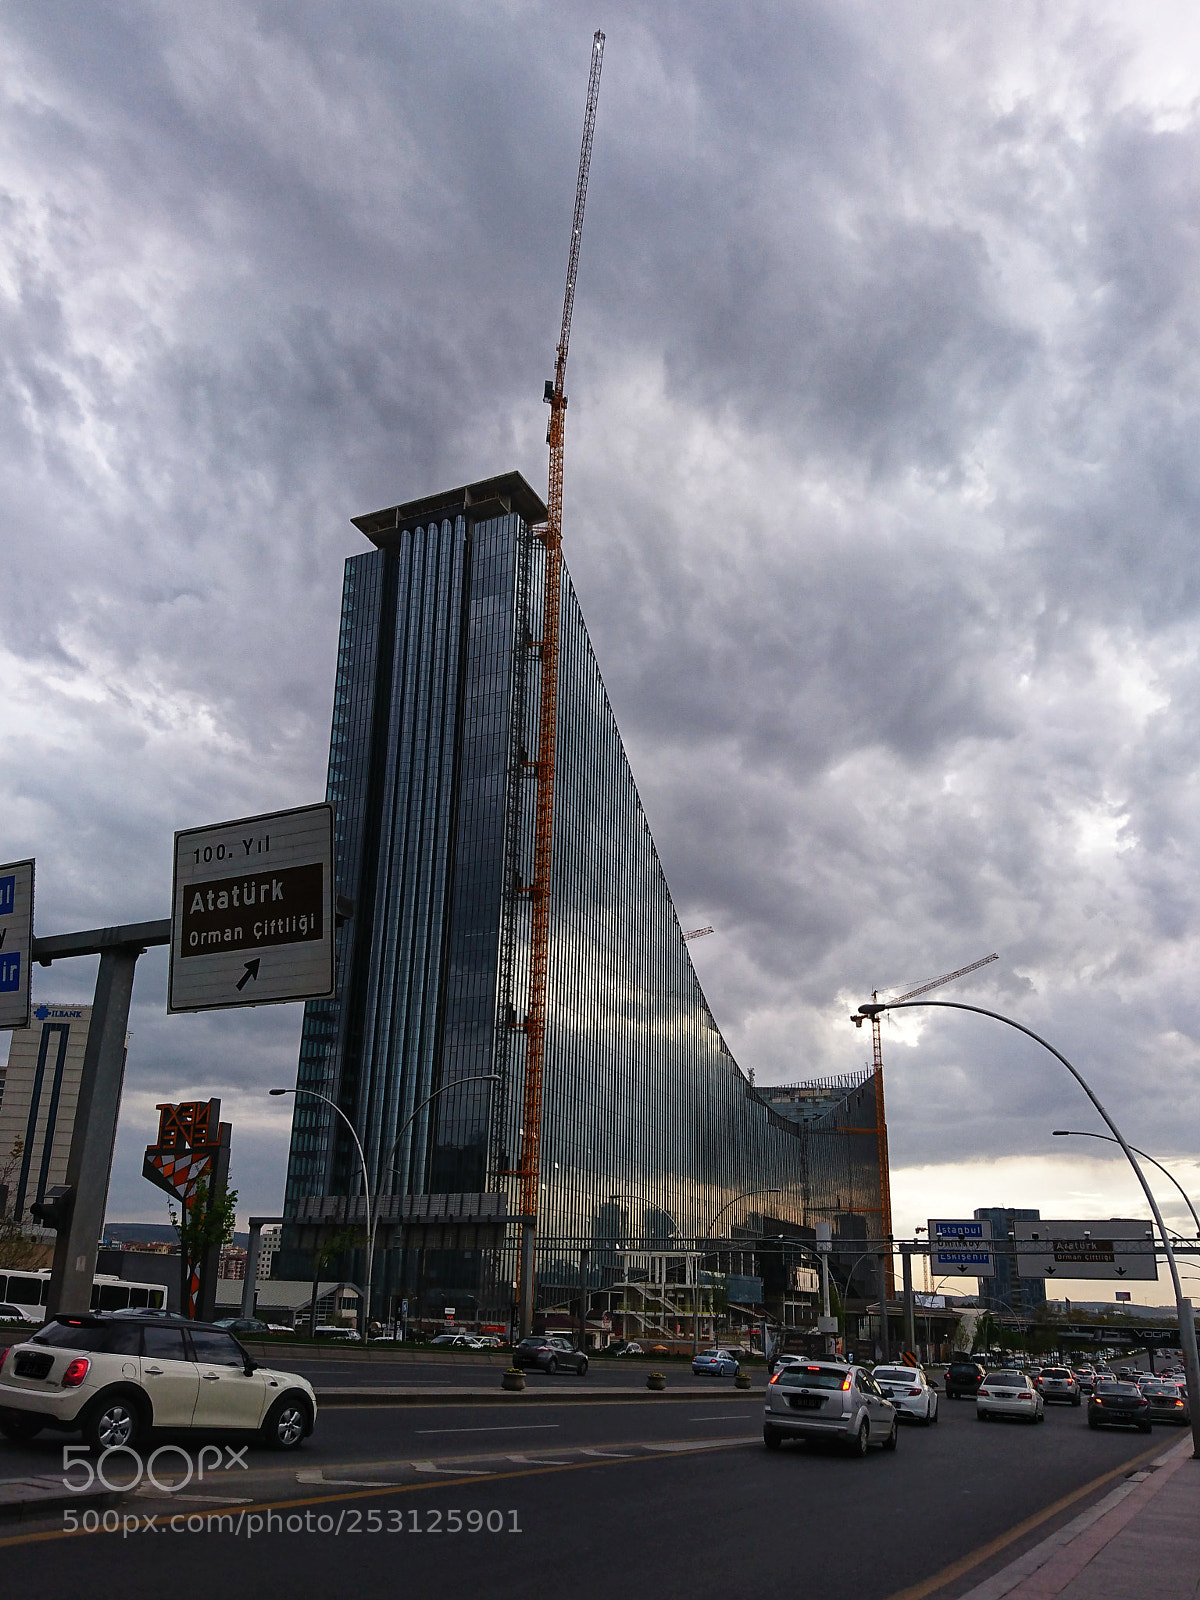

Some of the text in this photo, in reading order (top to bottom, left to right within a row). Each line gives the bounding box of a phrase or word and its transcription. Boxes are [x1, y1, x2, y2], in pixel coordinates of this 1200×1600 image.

[193, 843, 233, 864] 100.
[189, 879, 284, 914] Atatürk
[189, 913, 315, 947] Orman Çiftliği
